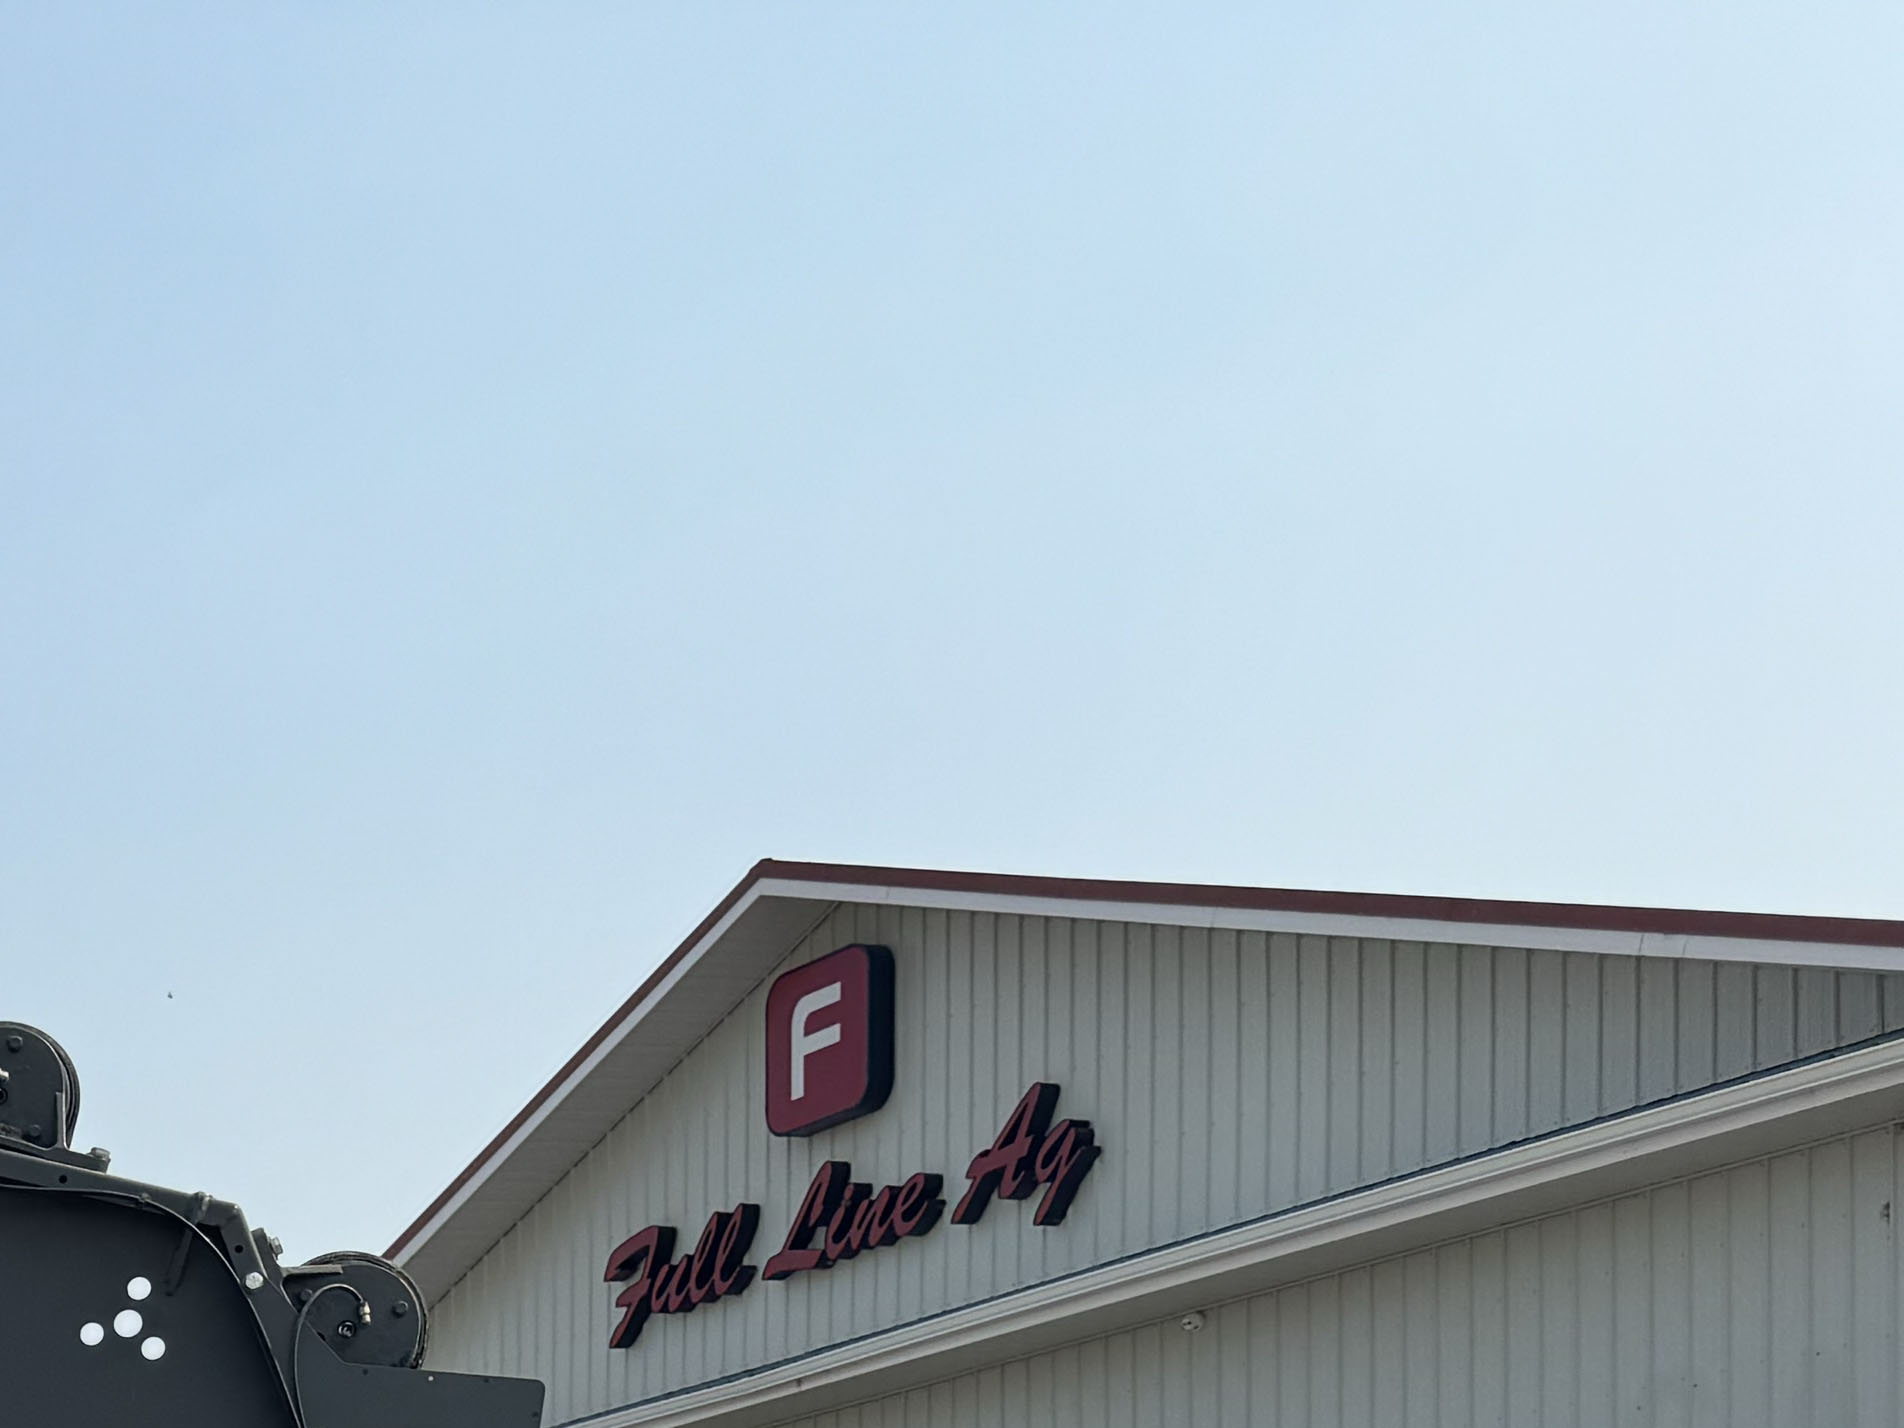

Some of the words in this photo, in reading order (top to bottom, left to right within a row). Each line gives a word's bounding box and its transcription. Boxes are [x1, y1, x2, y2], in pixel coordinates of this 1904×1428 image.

[791, 981, 841, 1101] F
[604, 1203, 759, 1349] Full
[762, 1160, 944, 1280] Line
[951, 1082, 1101, 1225] Ag
